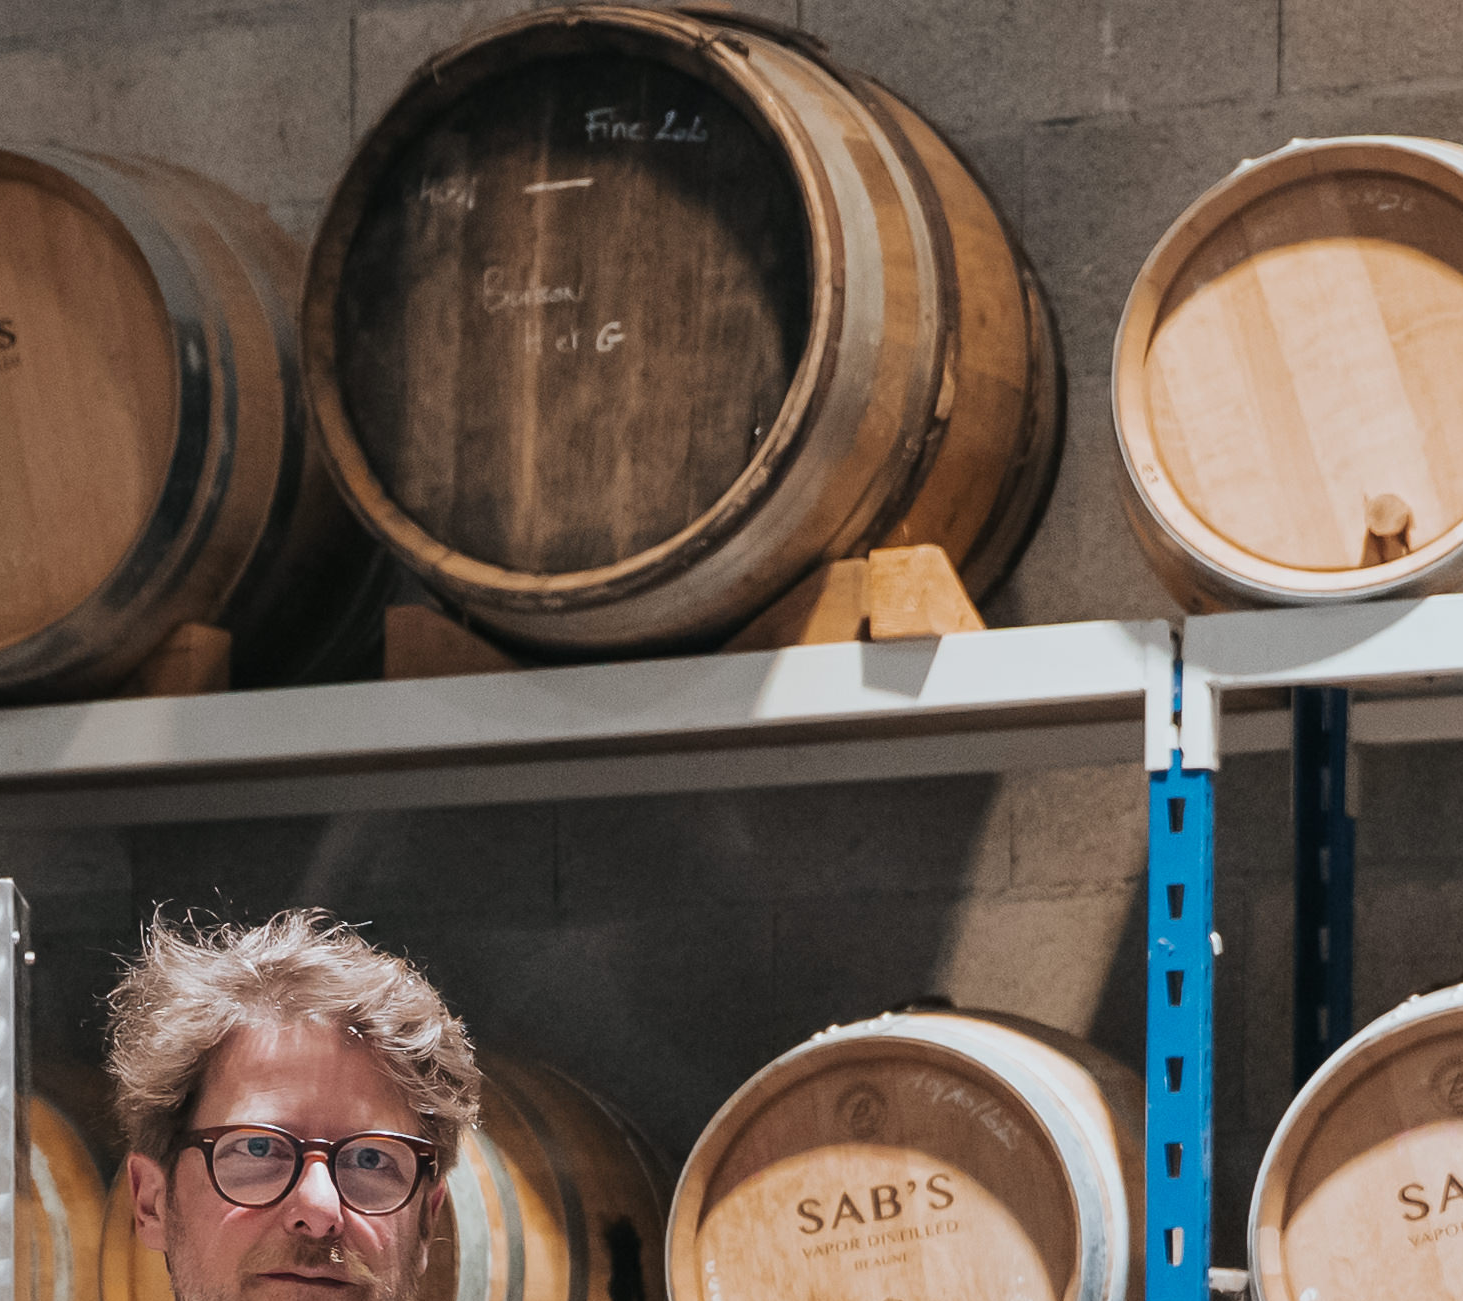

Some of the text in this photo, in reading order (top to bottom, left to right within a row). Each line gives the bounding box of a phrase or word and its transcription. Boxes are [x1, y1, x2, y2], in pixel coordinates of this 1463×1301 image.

[796, 1172, 955, 1235] SAB'S
[802, 1220, 960, 1260] VAPOR DISTILLED
